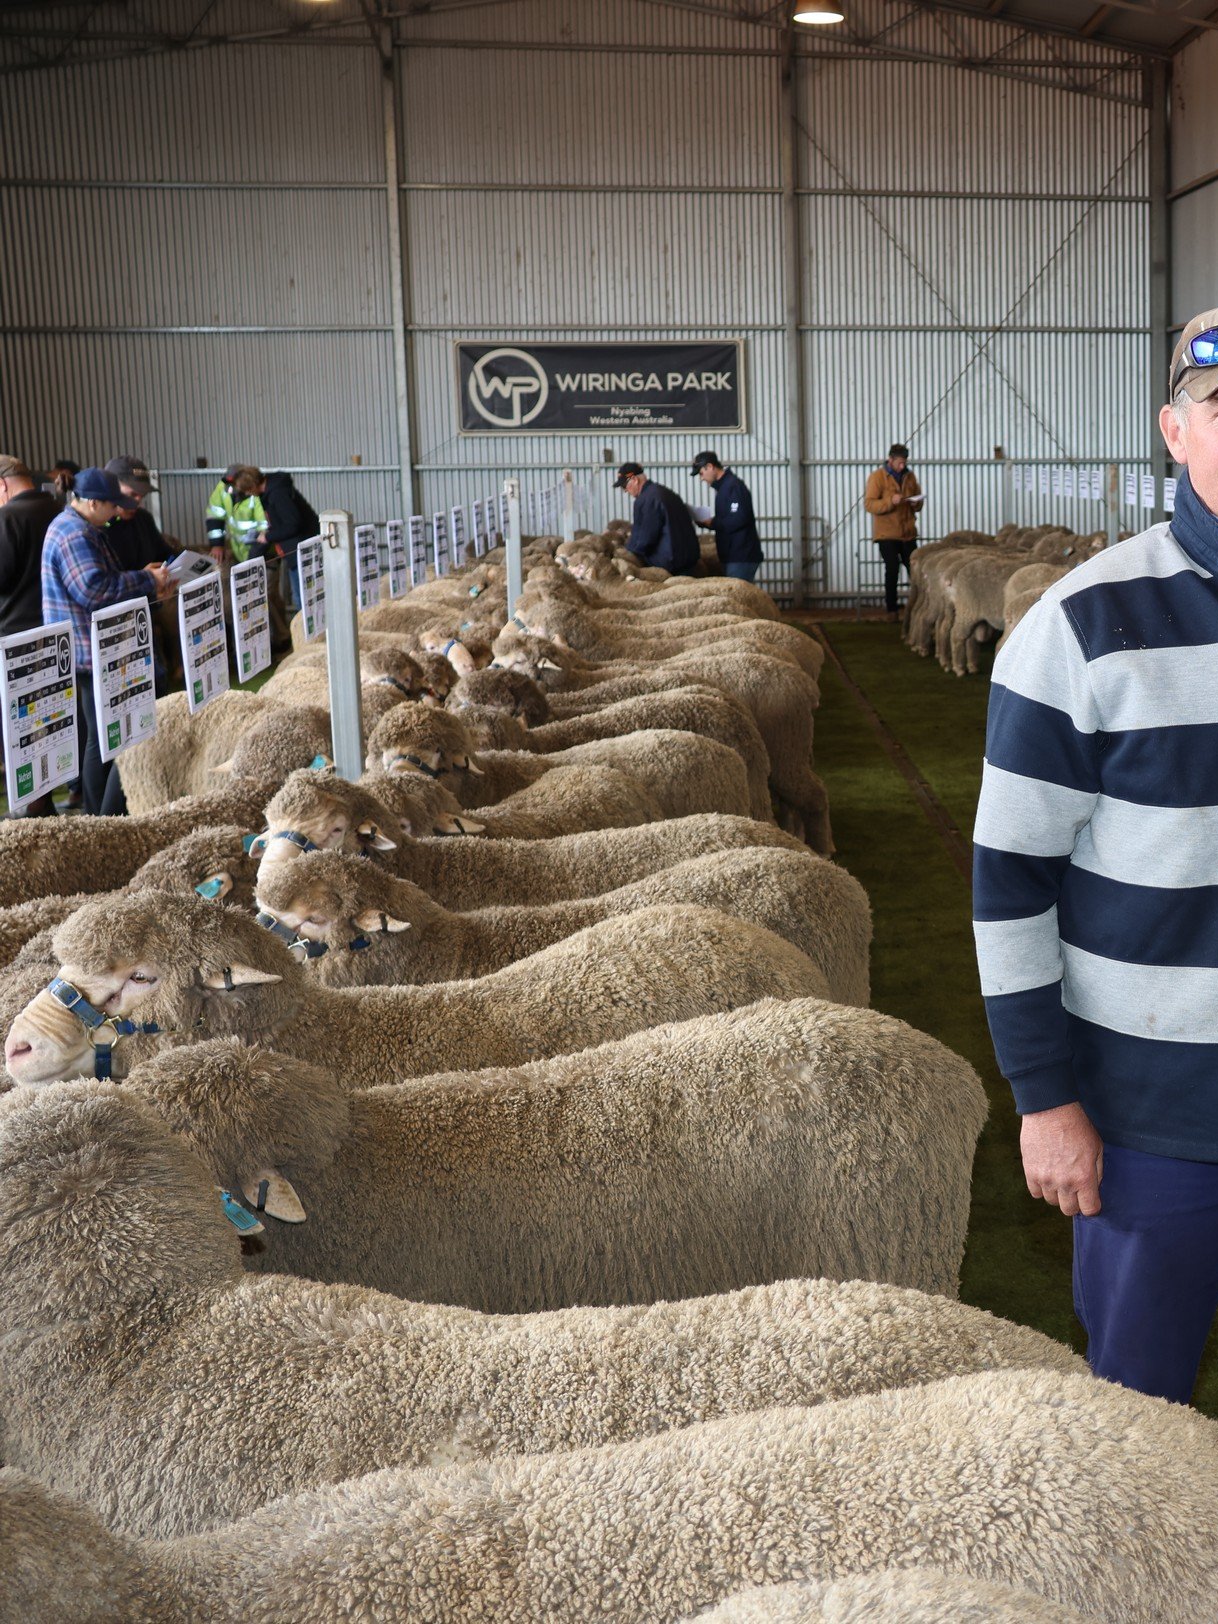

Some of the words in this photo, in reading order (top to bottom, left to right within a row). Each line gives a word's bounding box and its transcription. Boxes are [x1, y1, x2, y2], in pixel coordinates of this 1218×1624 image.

[555, 372, 662, 392] WIRINGA
[667, 371, 732, 391] PARK
[610, 406, 651, 417] Nyabing
[589, 415, 630, 425] Western
[632, 414, 674, 425] Australia
